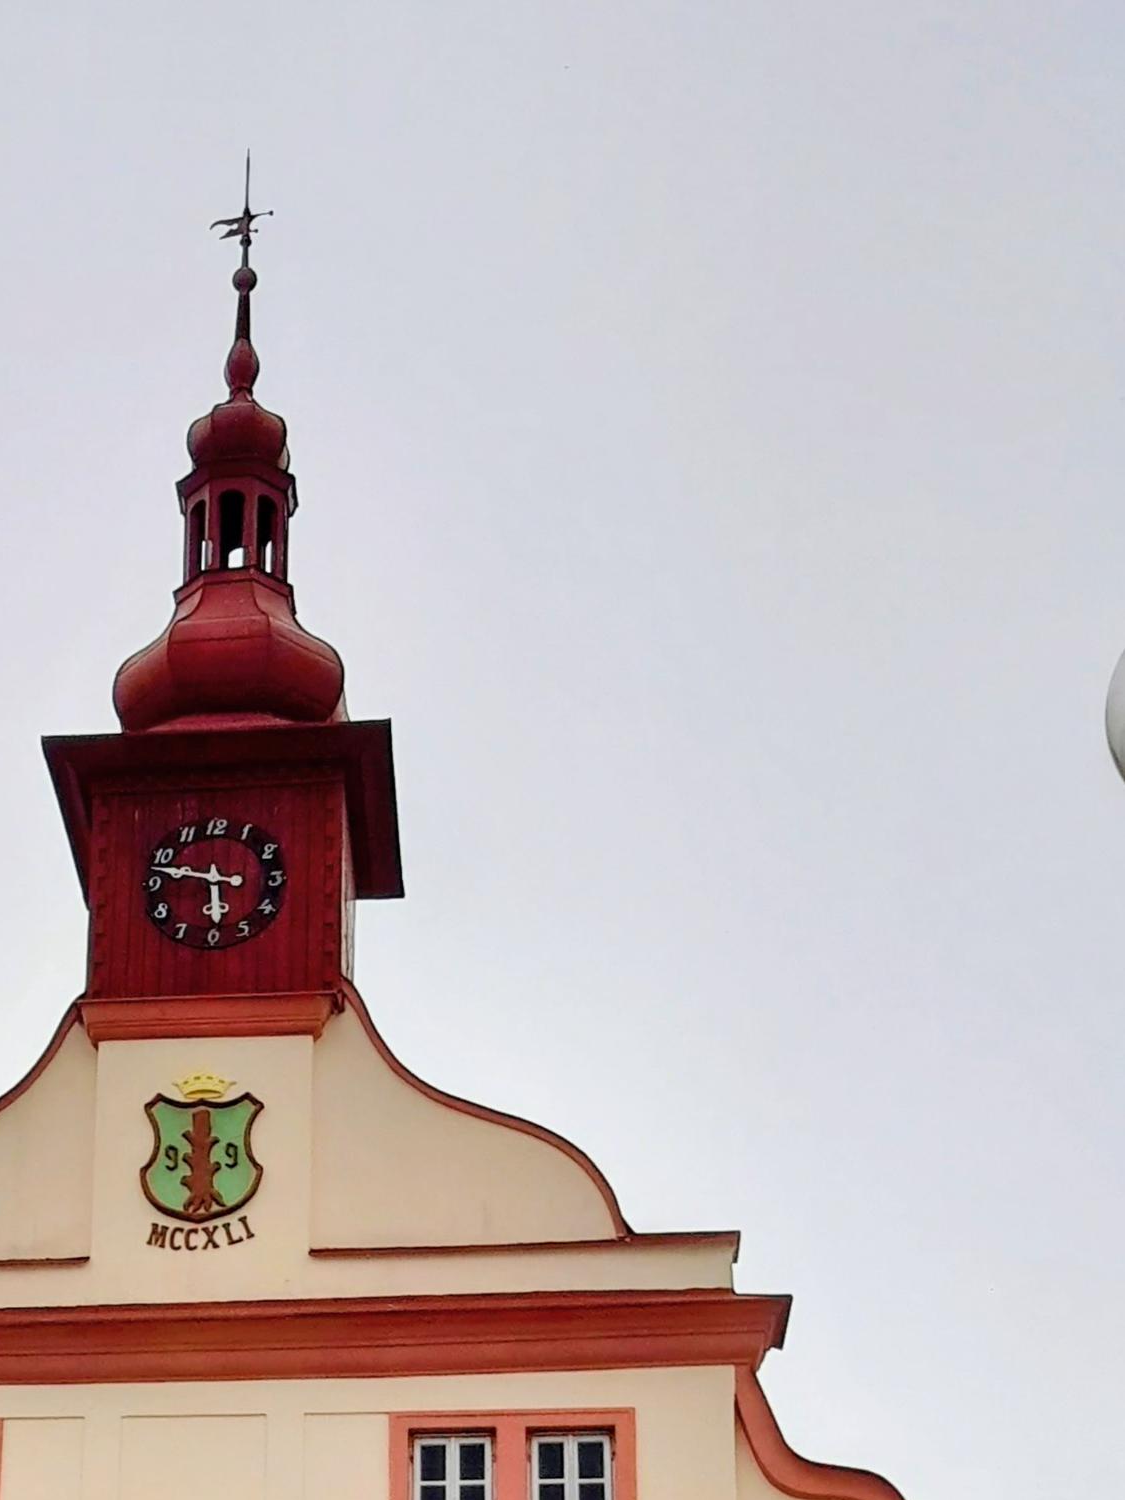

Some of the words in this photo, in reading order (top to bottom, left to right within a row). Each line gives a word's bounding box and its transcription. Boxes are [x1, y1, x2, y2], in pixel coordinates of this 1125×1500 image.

[179, 826, 196, 842] 11
[206, 819, 228, 835] 12
[241, 823, 253, 840] 1
[154, 848, 173, 864] 10
[262, 843, 278, 859] 2
[148, 876, 162, 892] 9
[268, 871, 284, 886] 3
[154, 903, 168, 918] 8
[258, 899, 276, 914] 4
[175, 923, 187, 939] 7
[236, 921, 250, 937] 5
[146, 1216, 255, 1251] MCCXLI
